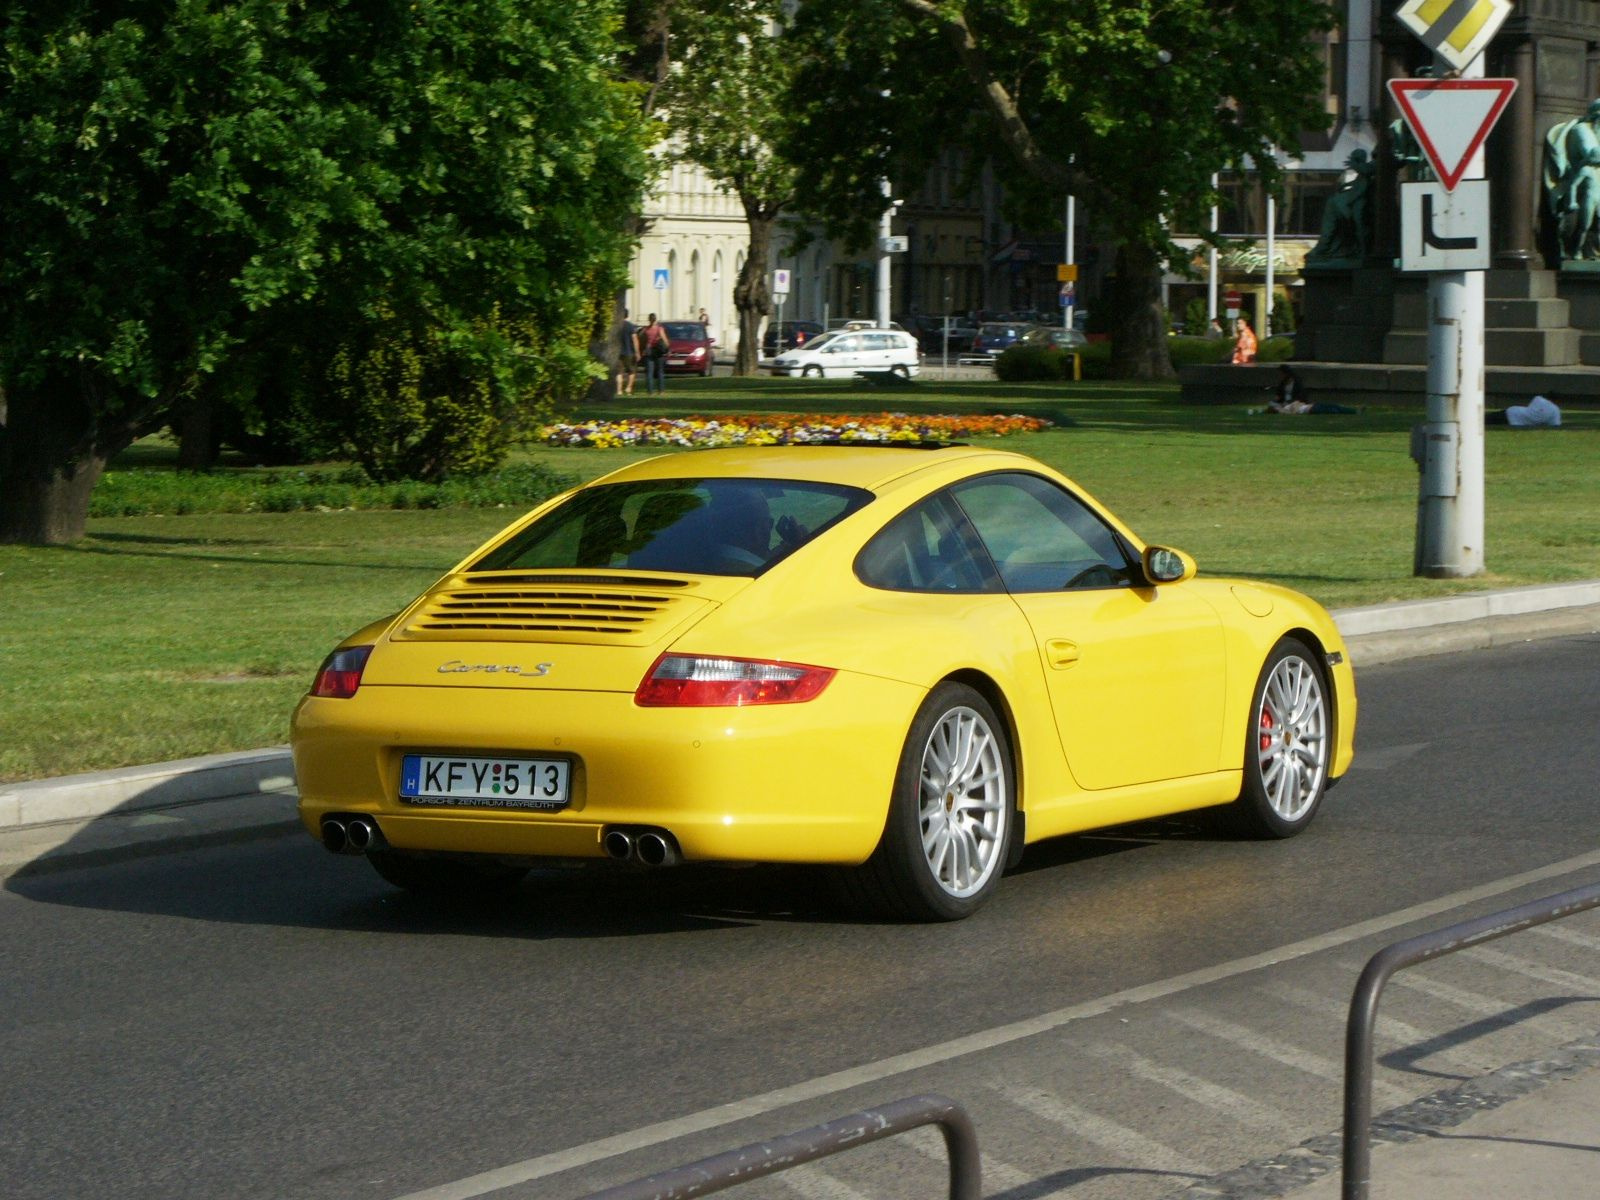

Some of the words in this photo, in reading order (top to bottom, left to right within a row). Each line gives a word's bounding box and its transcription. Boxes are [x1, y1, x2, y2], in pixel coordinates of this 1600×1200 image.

[437, 660, 521, 673] Carrera
[407, 779, 416, 790] H
[410, 797, 455, 805] PORSCHE
[458, 798, 504, 807] ZENTRUM
[506, 800, 555, 809] BAYREUTH
